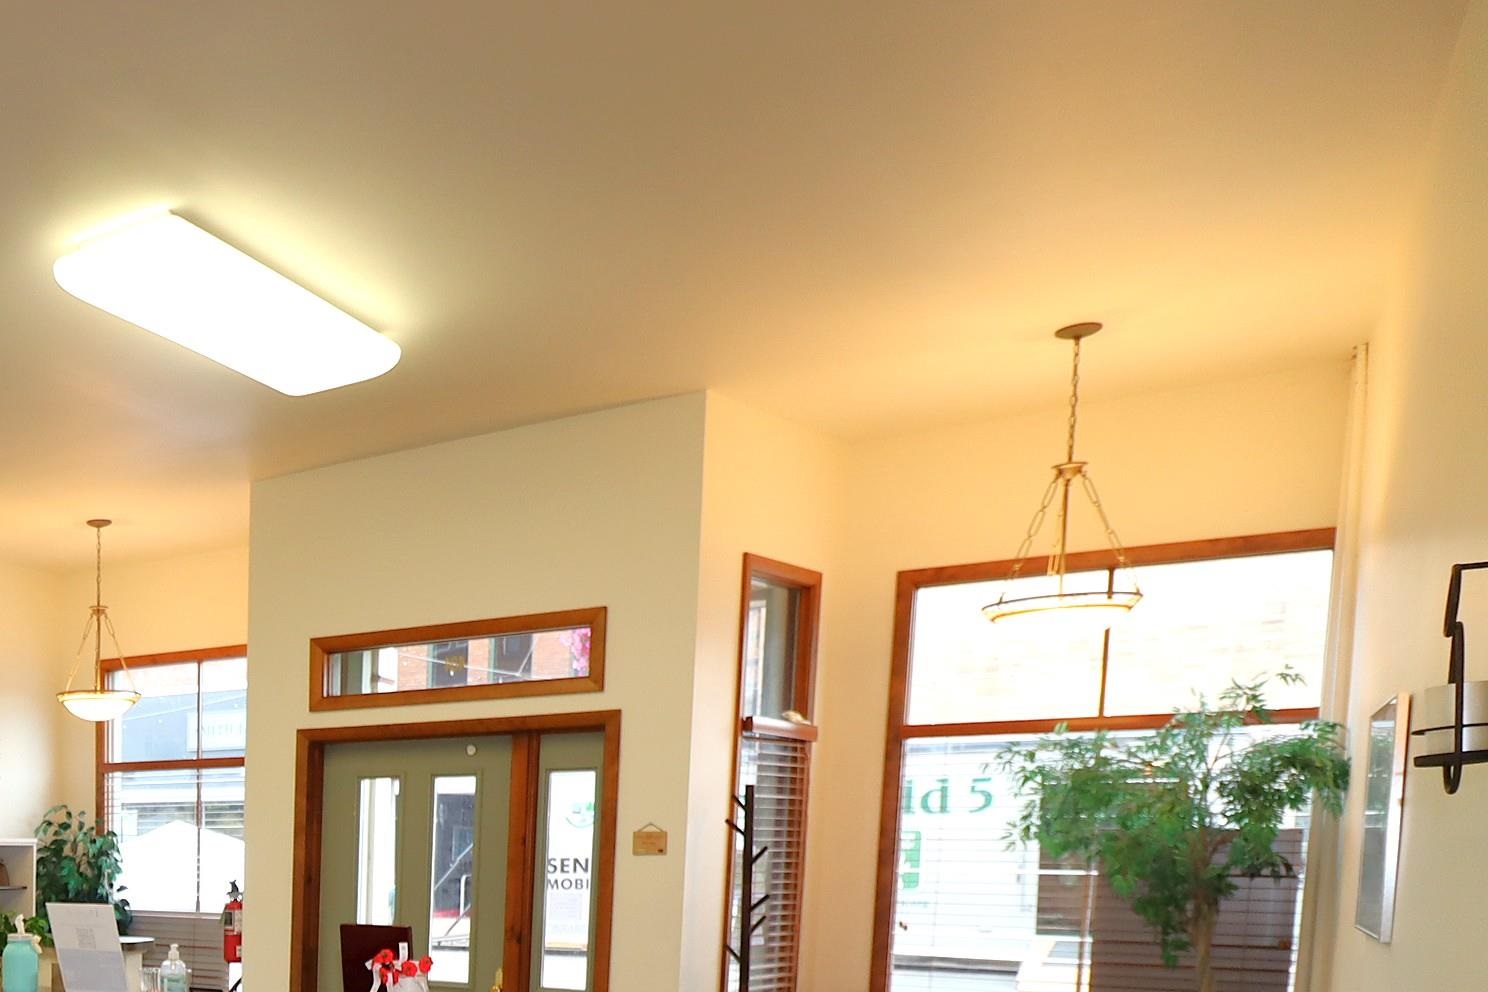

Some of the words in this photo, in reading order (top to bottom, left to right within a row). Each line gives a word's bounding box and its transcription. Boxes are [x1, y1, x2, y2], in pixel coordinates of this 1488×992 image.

[968, 777, 993, 813] 5
[547, 857, 589, 874] SEN
[547, 878, 589, 890] MOBI
